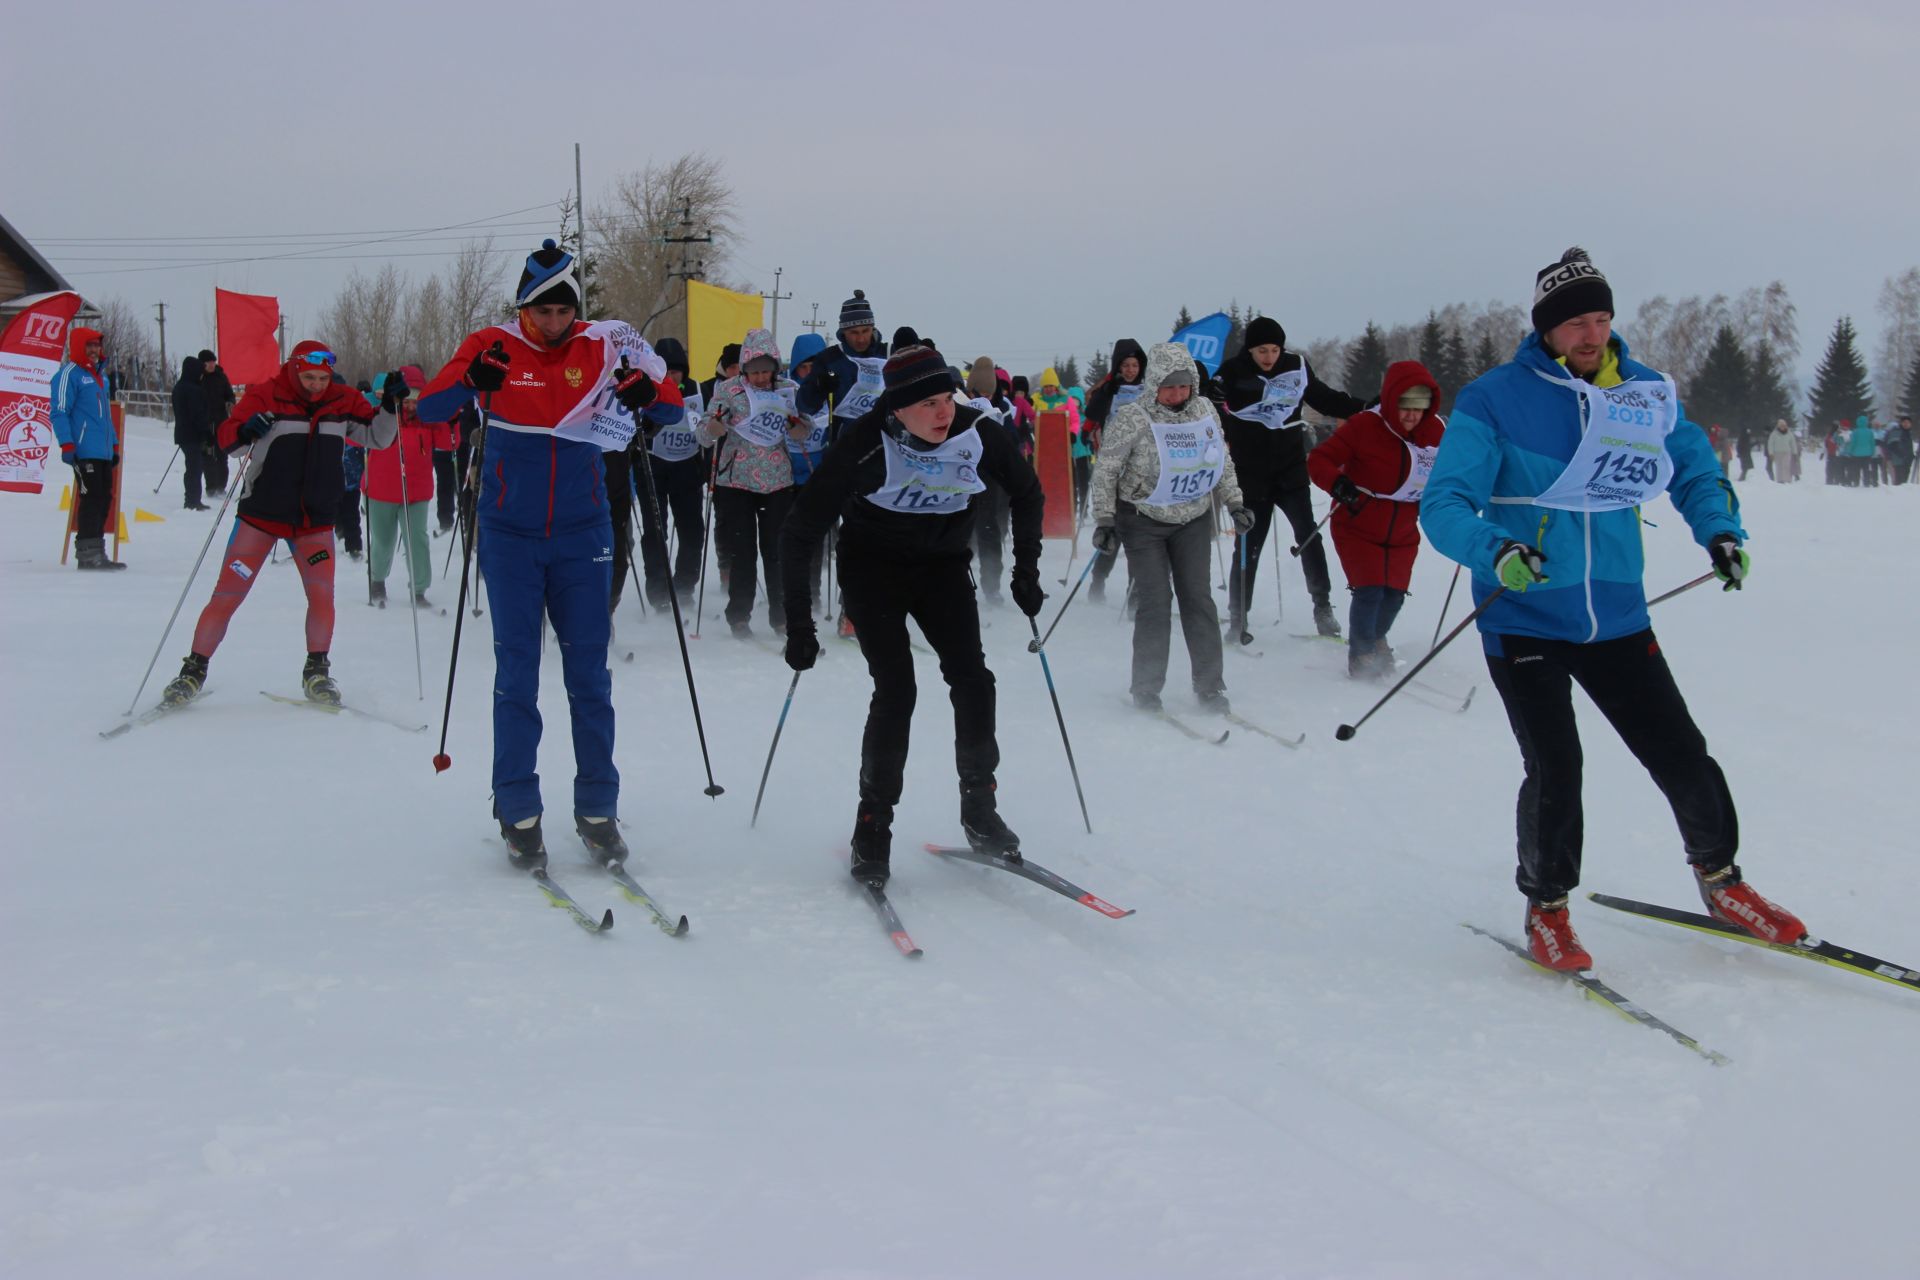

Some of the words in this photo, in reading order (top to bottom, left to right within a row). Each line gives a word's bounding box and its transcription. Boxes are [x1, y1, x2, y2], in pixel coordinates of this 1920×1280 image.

[24, 312, 65, 340] ГТО
[592, 412, 636, 434] РЕСПУБЛИК
[1607, 404, 1652, 427] 2023
[1164, 432, 1196, 441] ЛЫЖНЯ
[1166, 440, 1197, 448] РОССИИ
[21, 447, 44, 459] ГТО
[1168, 448, 1197, 458] 2023
[1170, 469, 1214, 493] 11571
